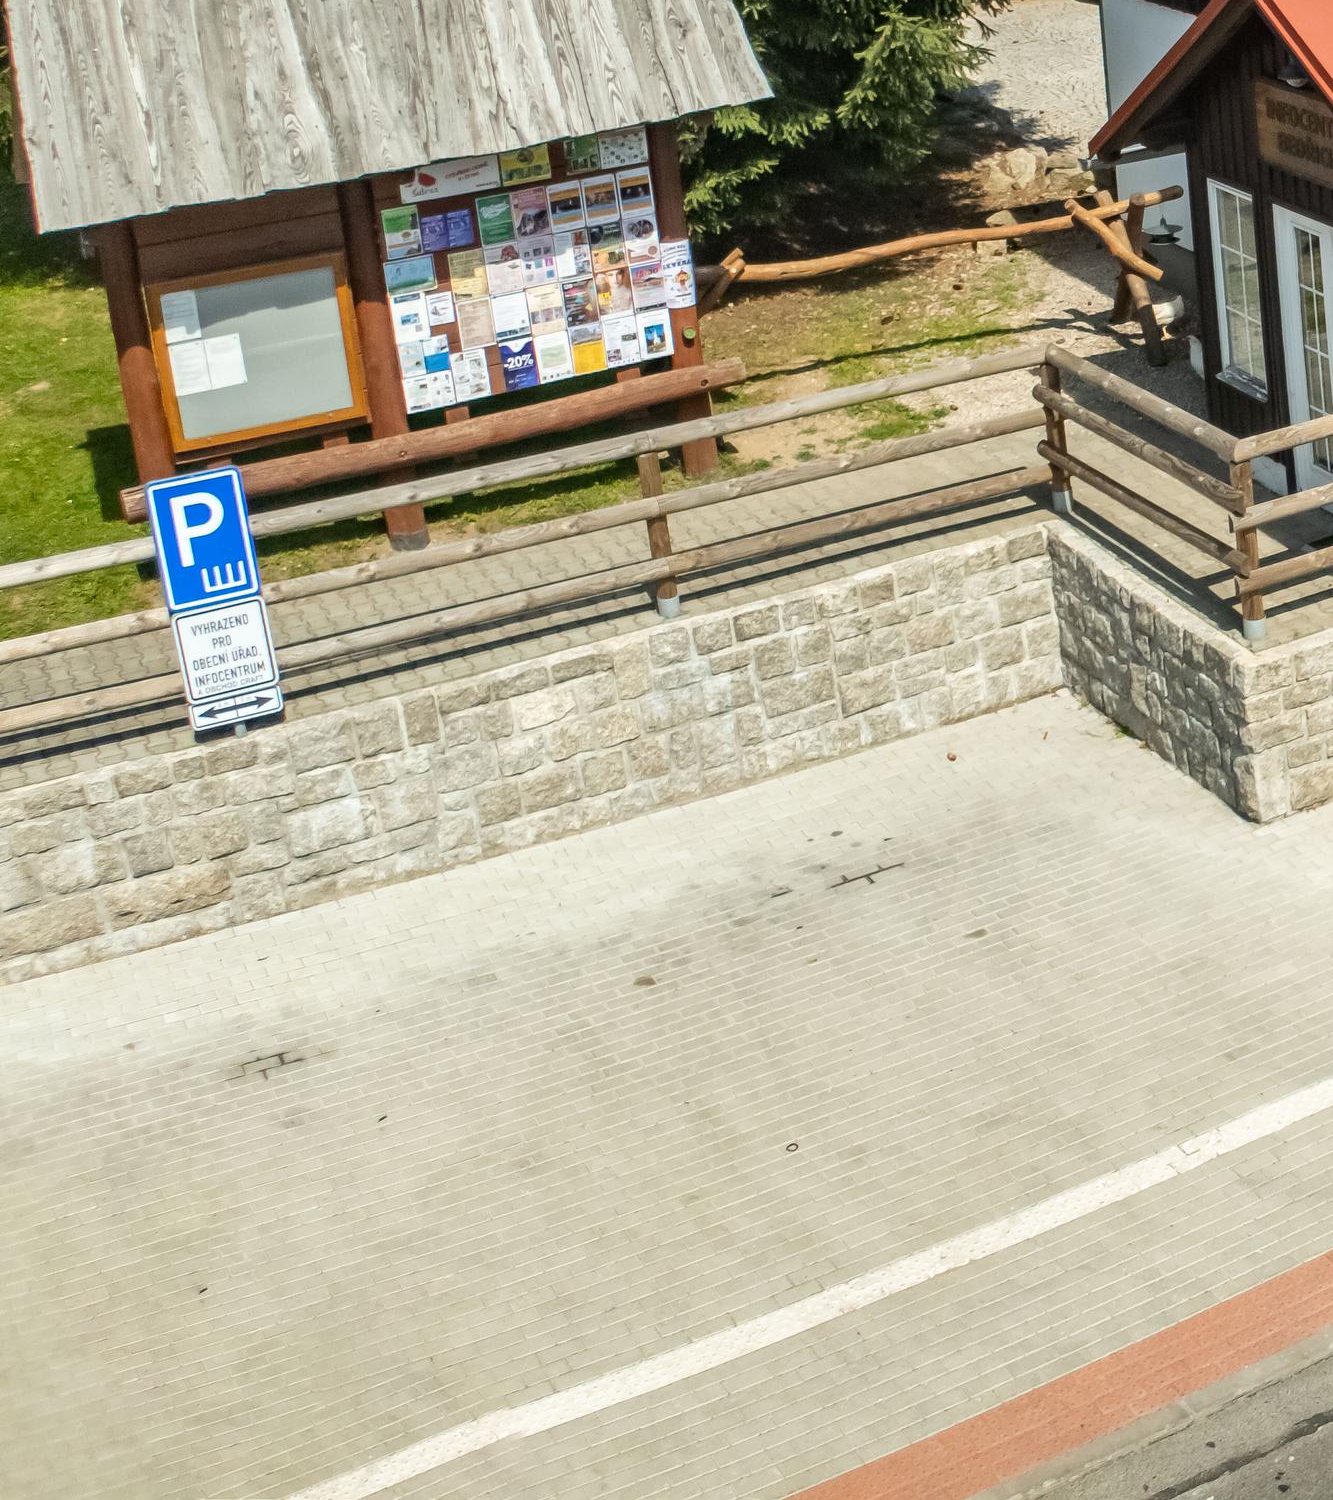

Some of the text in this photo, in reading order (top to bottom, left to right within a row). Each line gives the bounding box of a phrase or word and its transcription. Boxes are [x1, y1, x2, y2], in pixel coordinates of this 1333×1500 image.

[504, 353, 534, 369] -20%
[169, 492, 224, 567] P
[190, 613, 249, 636] VYHRAZENO
[212, 635, 232, 649] PRO
[195, 661, 266, 687] INFOCENTRUM
